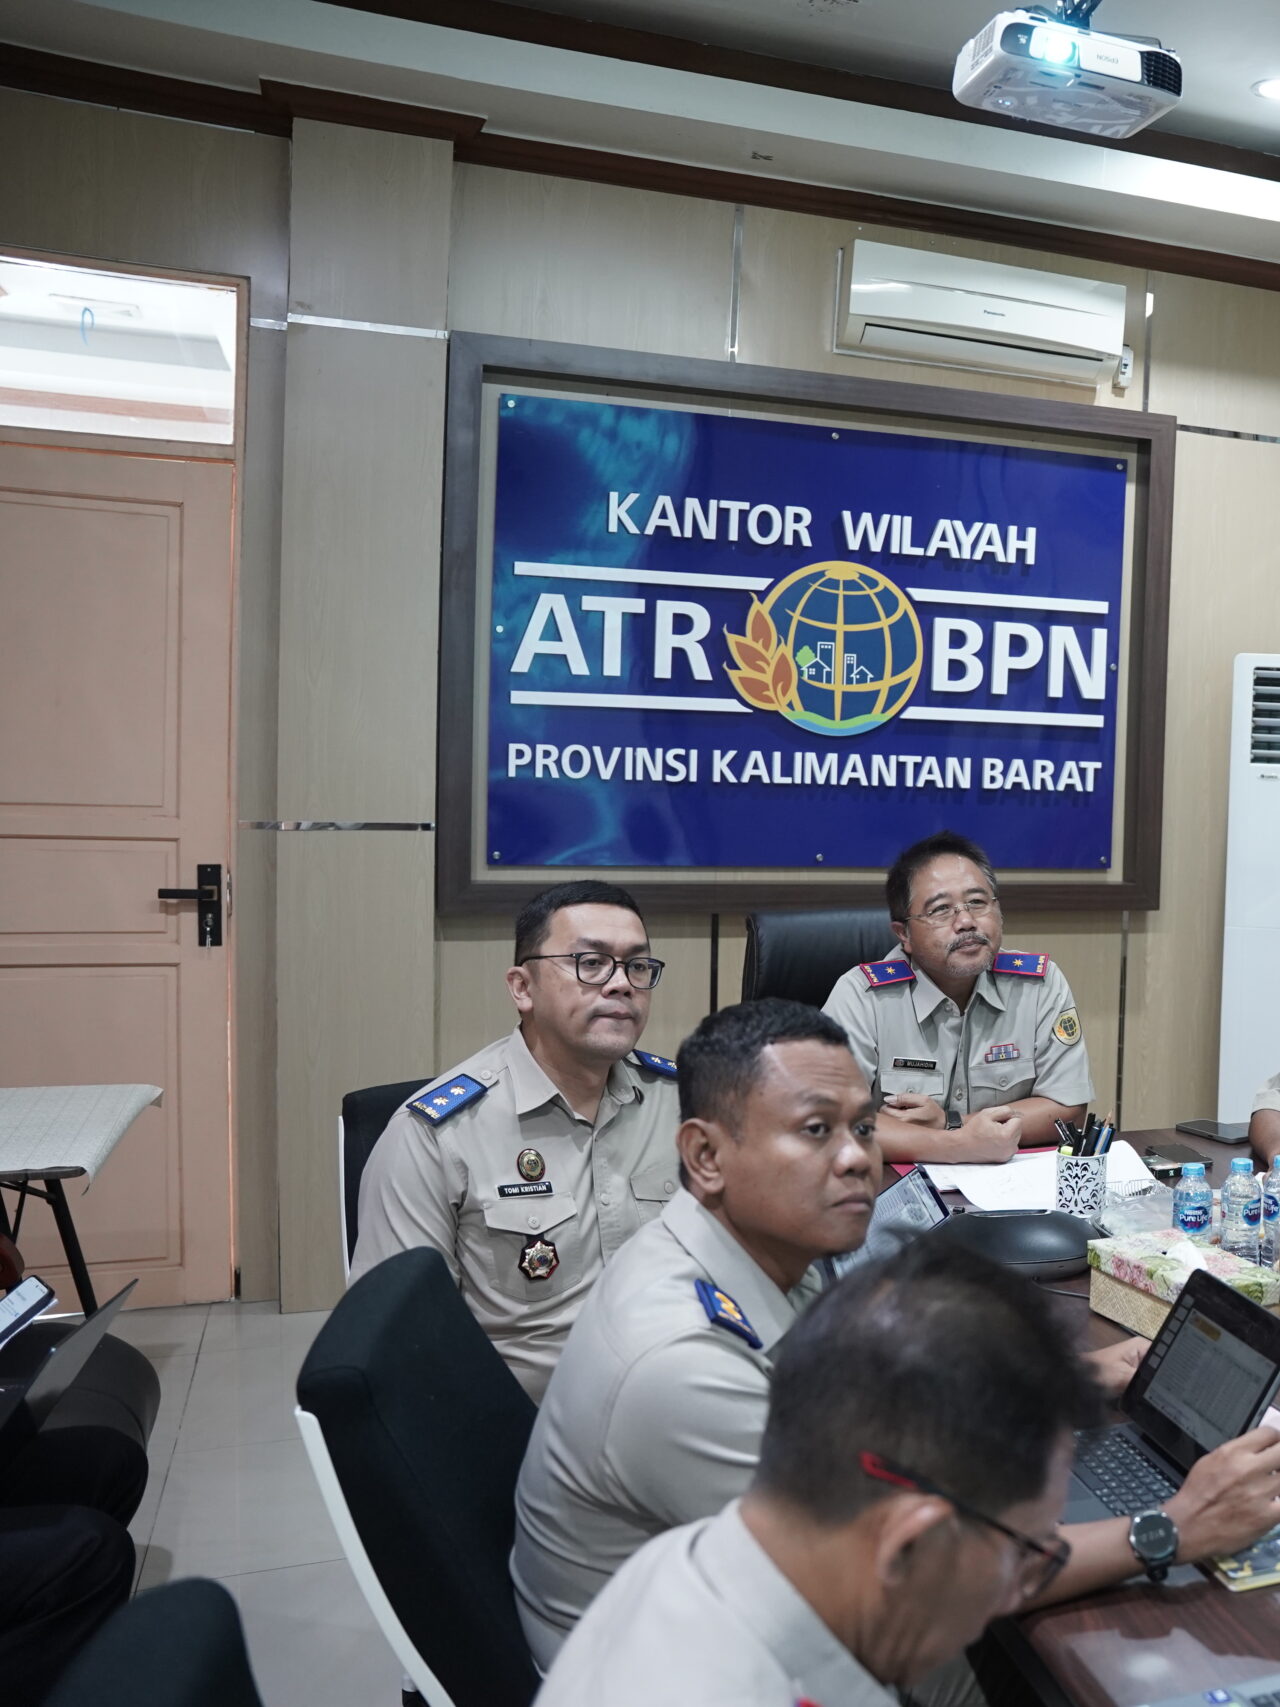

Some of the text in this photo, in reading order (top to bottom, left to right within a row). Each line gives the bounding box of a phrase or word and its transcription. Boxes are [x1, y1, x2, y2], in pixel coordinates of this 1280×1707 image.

[607, 491, 1037, 566] KANTOR WILAYAH
[510, 593, 1108, 701] ATR BPN
[507, 742, 1102, 794] PROVINSI KALIMANTAN BARAT
[520, 1184, 546, 1192] KRISTIAN
[1180, 1214, 1208, 1224] Pure Life
